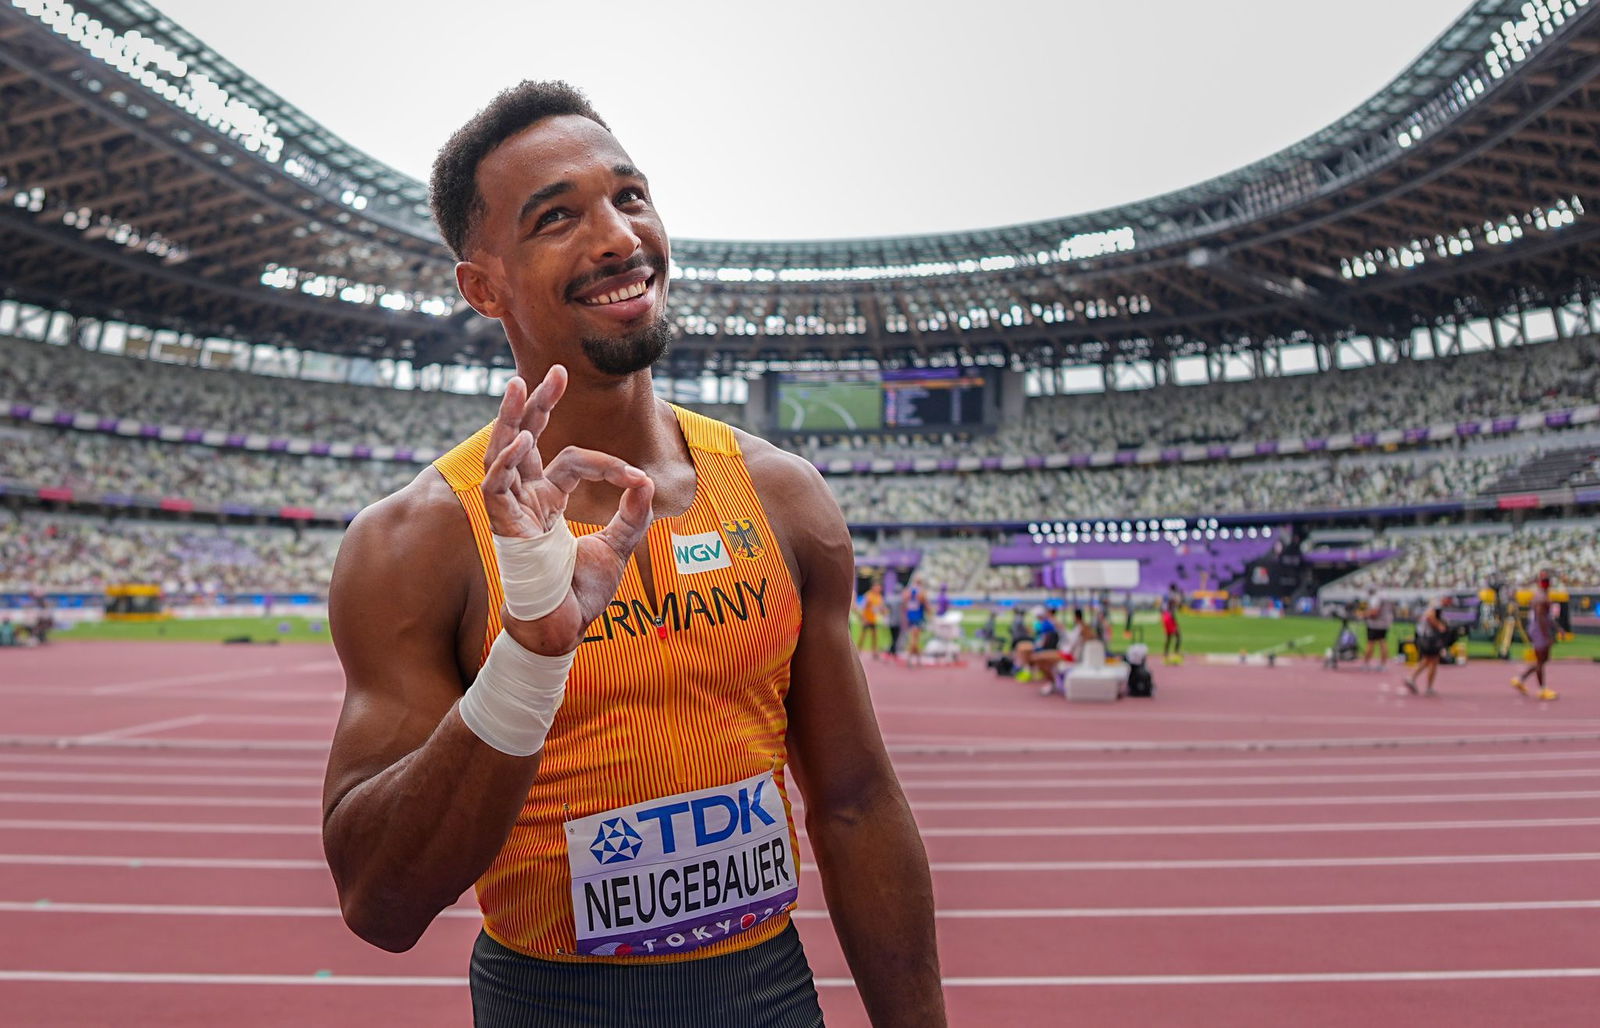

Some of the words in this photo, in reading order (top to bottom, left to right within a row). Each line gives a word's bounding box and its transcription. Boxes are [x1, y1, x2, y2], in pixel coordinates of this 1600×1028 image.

[673, 540, 721, 564] WGV
[582, 578, 767, 643] RMANY
[636, 780, 776, 854] TDK
[584, 837, 790, 932] NEUGEBAUER
